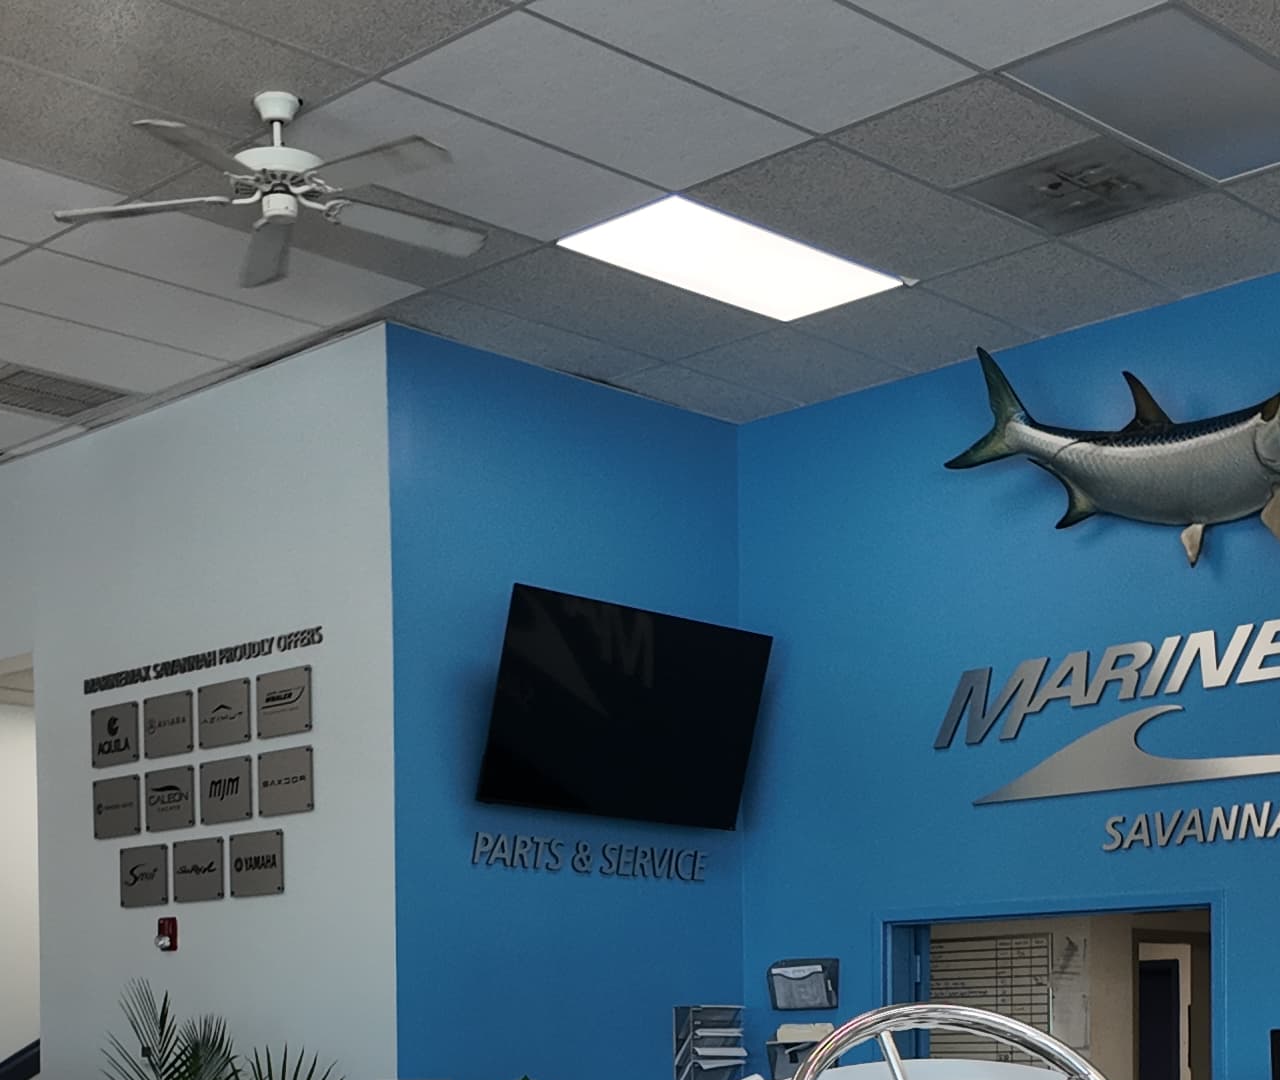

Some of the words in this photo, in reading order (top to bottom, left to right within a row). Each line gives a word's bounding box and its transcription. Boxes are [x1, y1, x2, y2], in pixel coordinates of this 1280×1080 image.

[218, 636, 275, 665] PROUDLY
[276, 625, 324, 653] OFFERS
[244, 853, 278, 871] YAMAHA
[471, 831, 565, 872] PARTS
[571, 839, 593, 875] &
[598, 843, 708, 883] SERVICE
